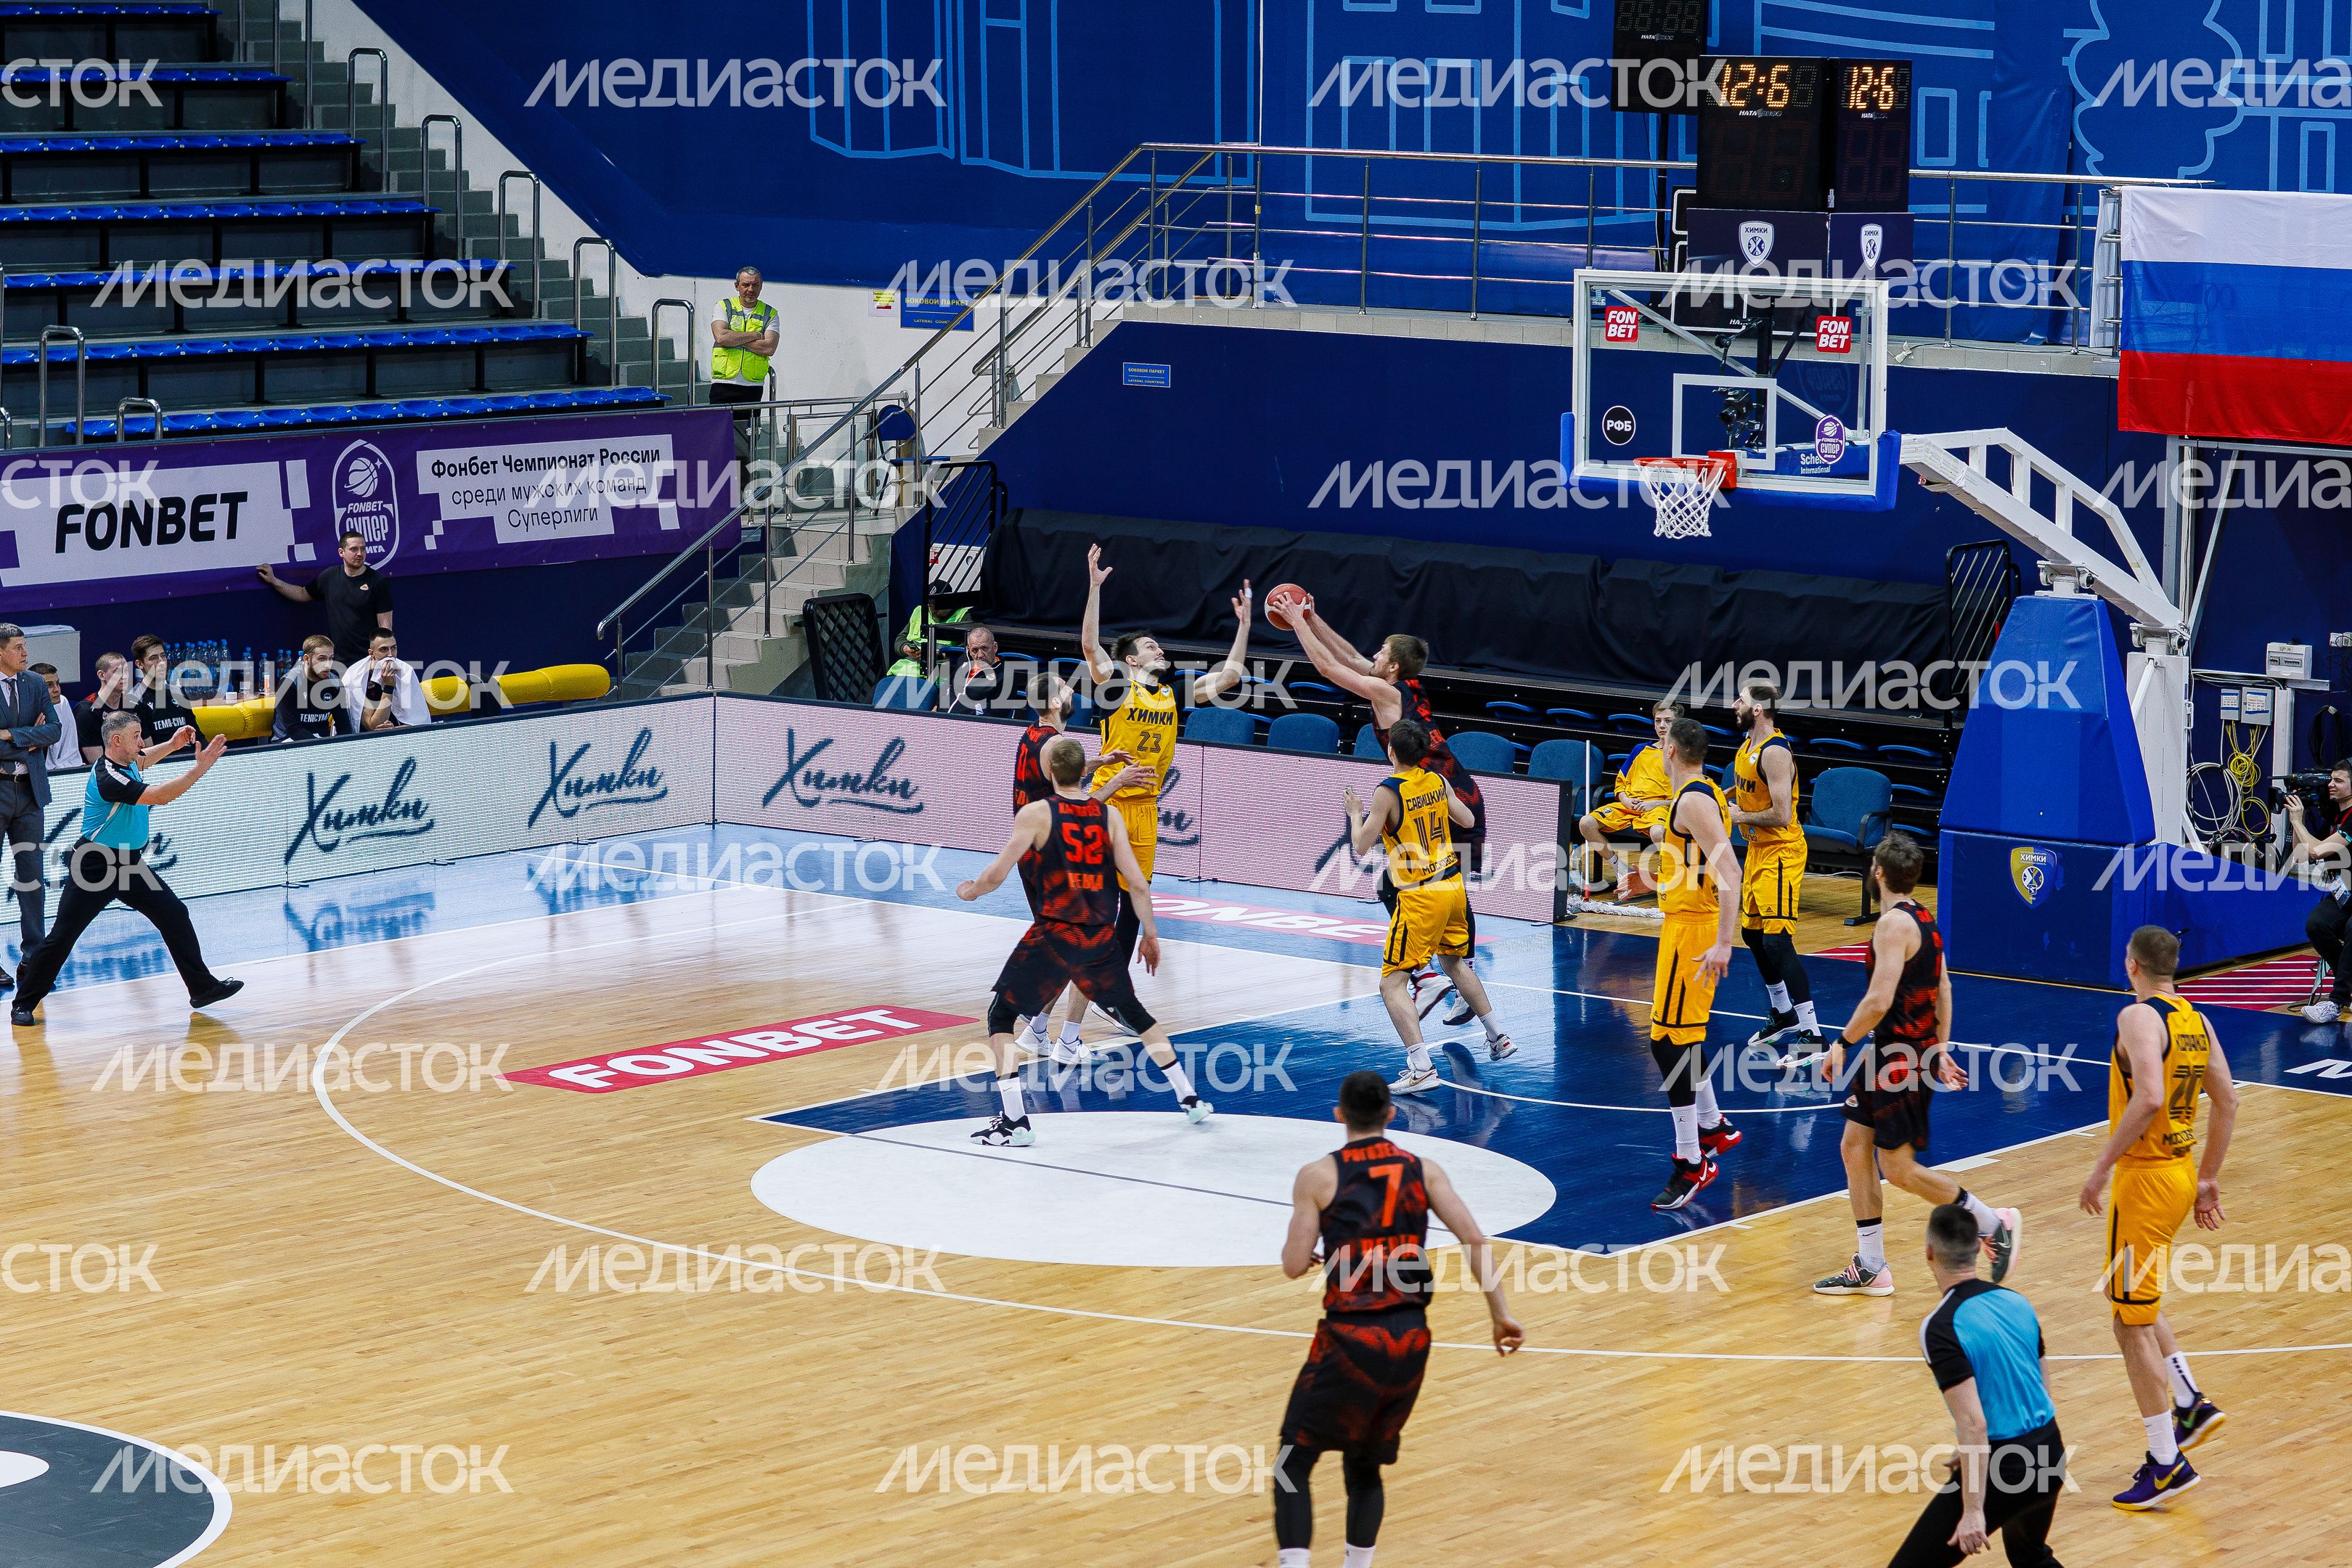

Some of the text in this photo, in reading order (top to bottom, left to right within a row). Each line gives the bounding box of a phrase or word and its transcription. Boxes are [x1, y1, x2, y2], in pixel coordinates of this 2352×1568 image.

[1607, 310, 1637, 324] FON
[1607, 324, 1637, 338] BET
[1818, 320, 1850, 334] FON
[1818, 334, 1849, 348] BET
[1606, 420, 1632, 432] РФБ
[431, 448, 661, 478] Фонбет Чемпионат России
[347, 500, 383, 514] FONBET
[452, 477, 648, 510] среди мужских команд
[55, 491, 248, 554] FONBET
[507, 507, 599, 532] Суперлиги
[365, 545, 385, 554] ИГА
[1127, 708, 1174, 725] ХИМКИ
[1137, 732, 1162, 753] 23
[528, 727, 667, 829] Химки
[763, 727, 922, 812] Химки
[284, 756, 433, 865] Химки
[1406, 784, 1446, 812] САВИЦКИЙ
[1061, 822, 1103, 865] 52
[1413, 811, 1447, 857] 14
[2020, 854, 2046, 862] ХИМКИ
[1152, 899, 1389, 943] ONBE
[547, 1009, 923, 1088] FONBET
[1368, 1164, 1405, 1228] 7
